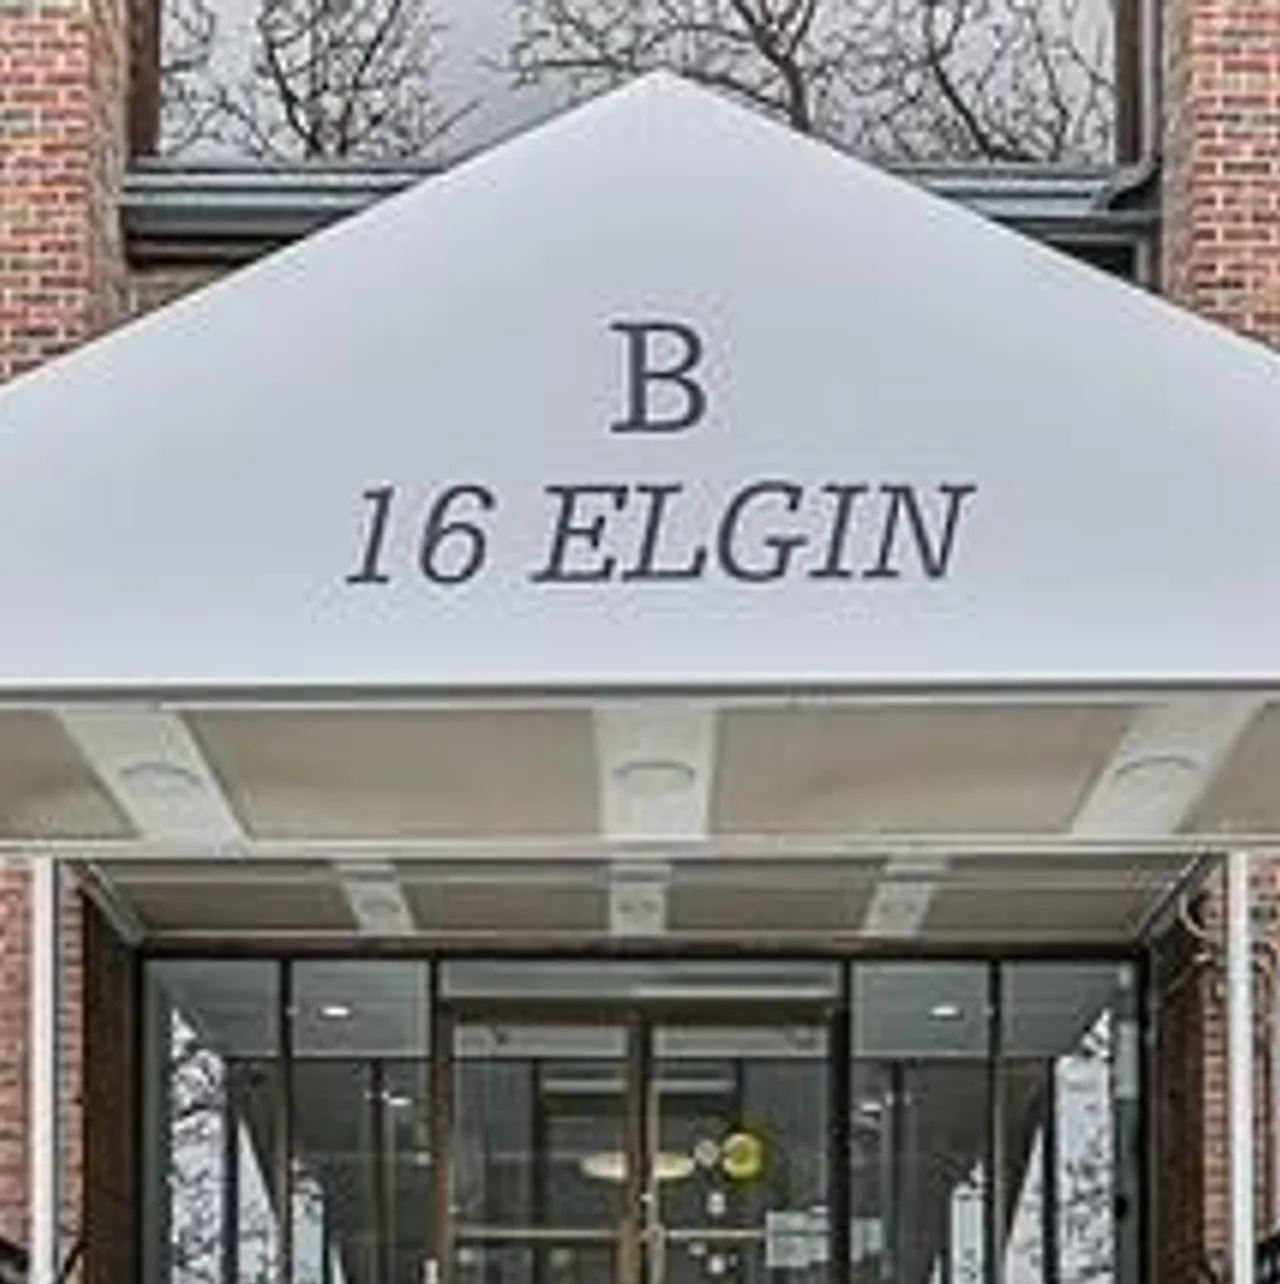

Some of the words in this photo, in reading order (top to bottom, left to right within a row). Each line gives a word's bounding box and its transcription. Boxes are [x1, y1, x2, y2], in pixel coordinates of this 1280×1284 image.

[610, 322, 707, 433] B
[346, 486, 496, 583] 16
[531, 481, 976, 583] ELGIN
